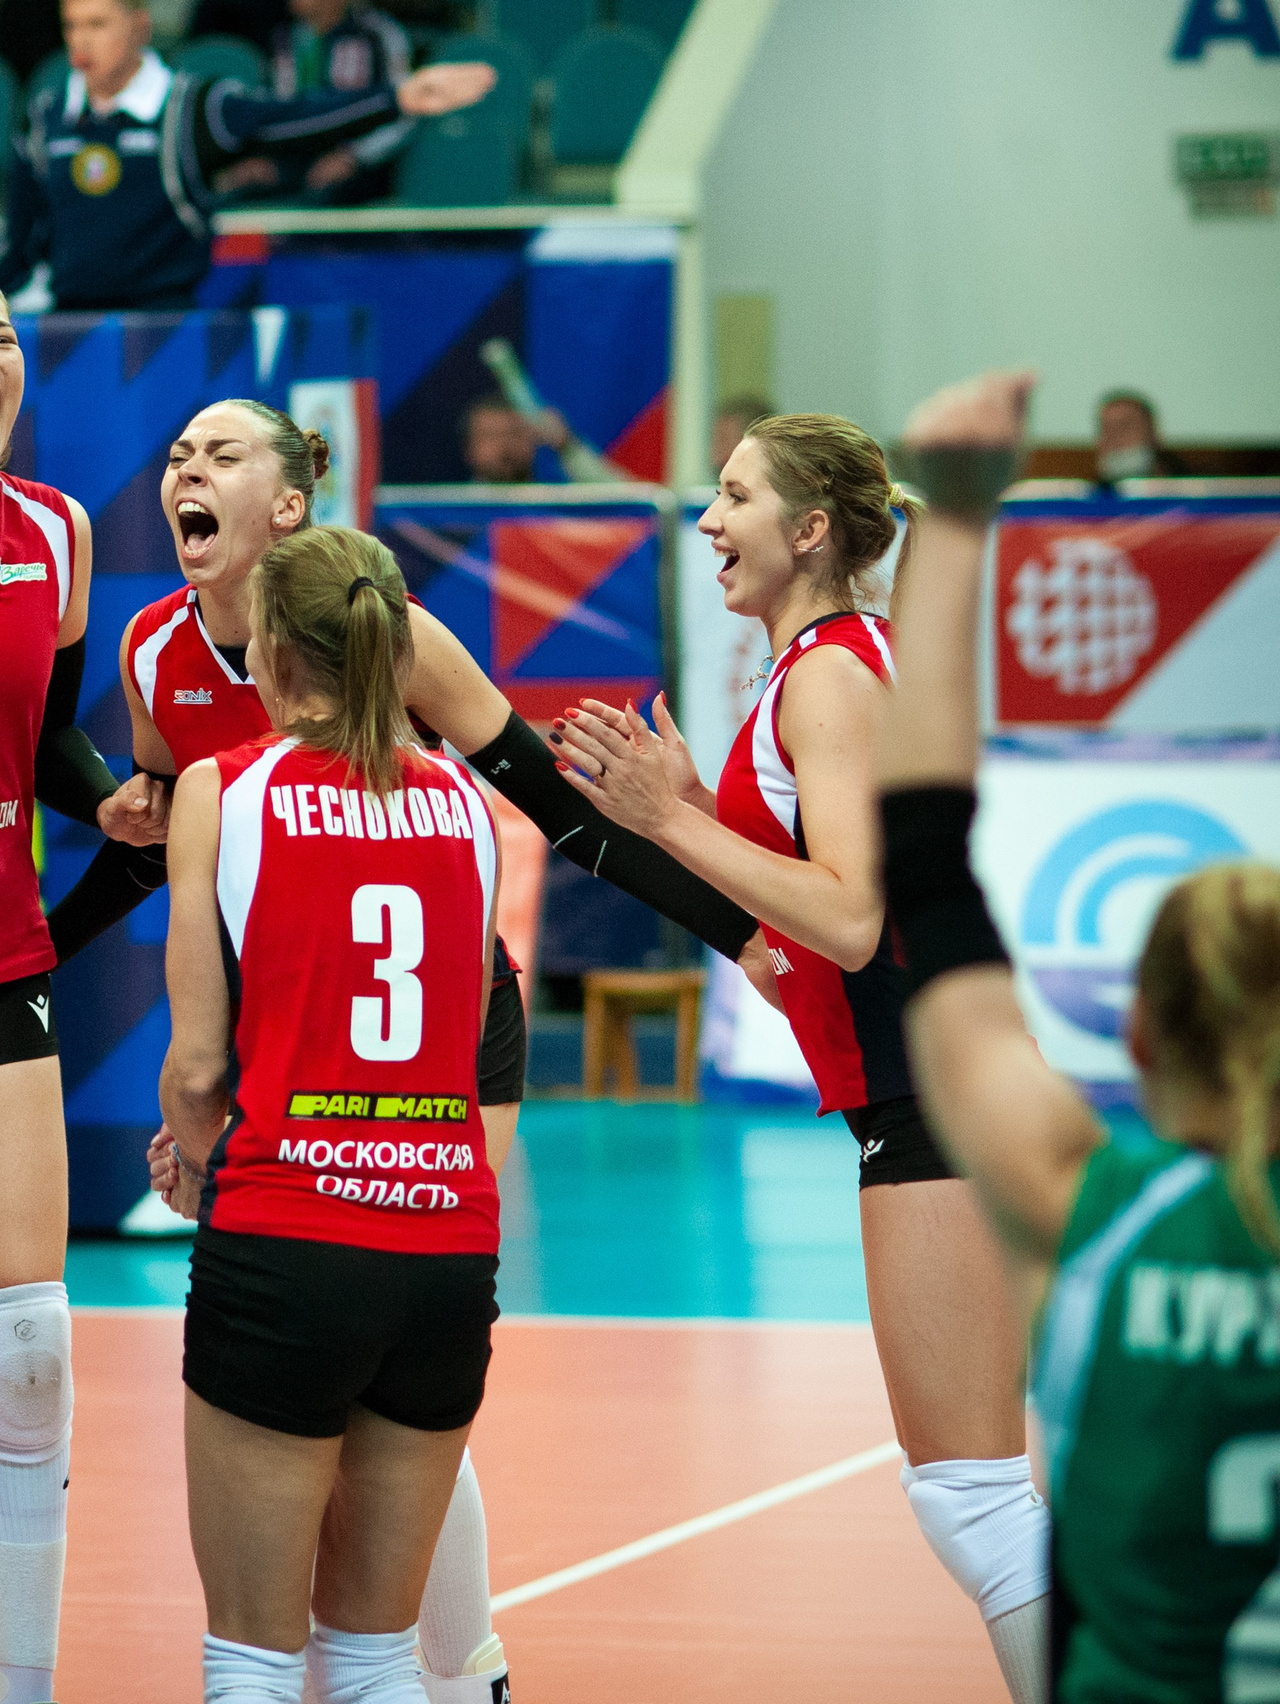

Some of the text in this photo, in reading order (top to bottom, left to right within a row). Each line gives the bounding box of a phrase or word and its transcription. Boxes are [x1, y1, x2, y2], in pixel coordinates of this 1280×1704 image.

[270, 784, 473, 840] ЧЕСНОКОВА
[350, 884, 424, 1062] 3
[289, 1095, 467, 1119] PARI MATCH
[278, 1139, 474, 1170] МОСКОВСКАЯ
[316, 1174, 459, 1209] ОБЛАСТЬ
